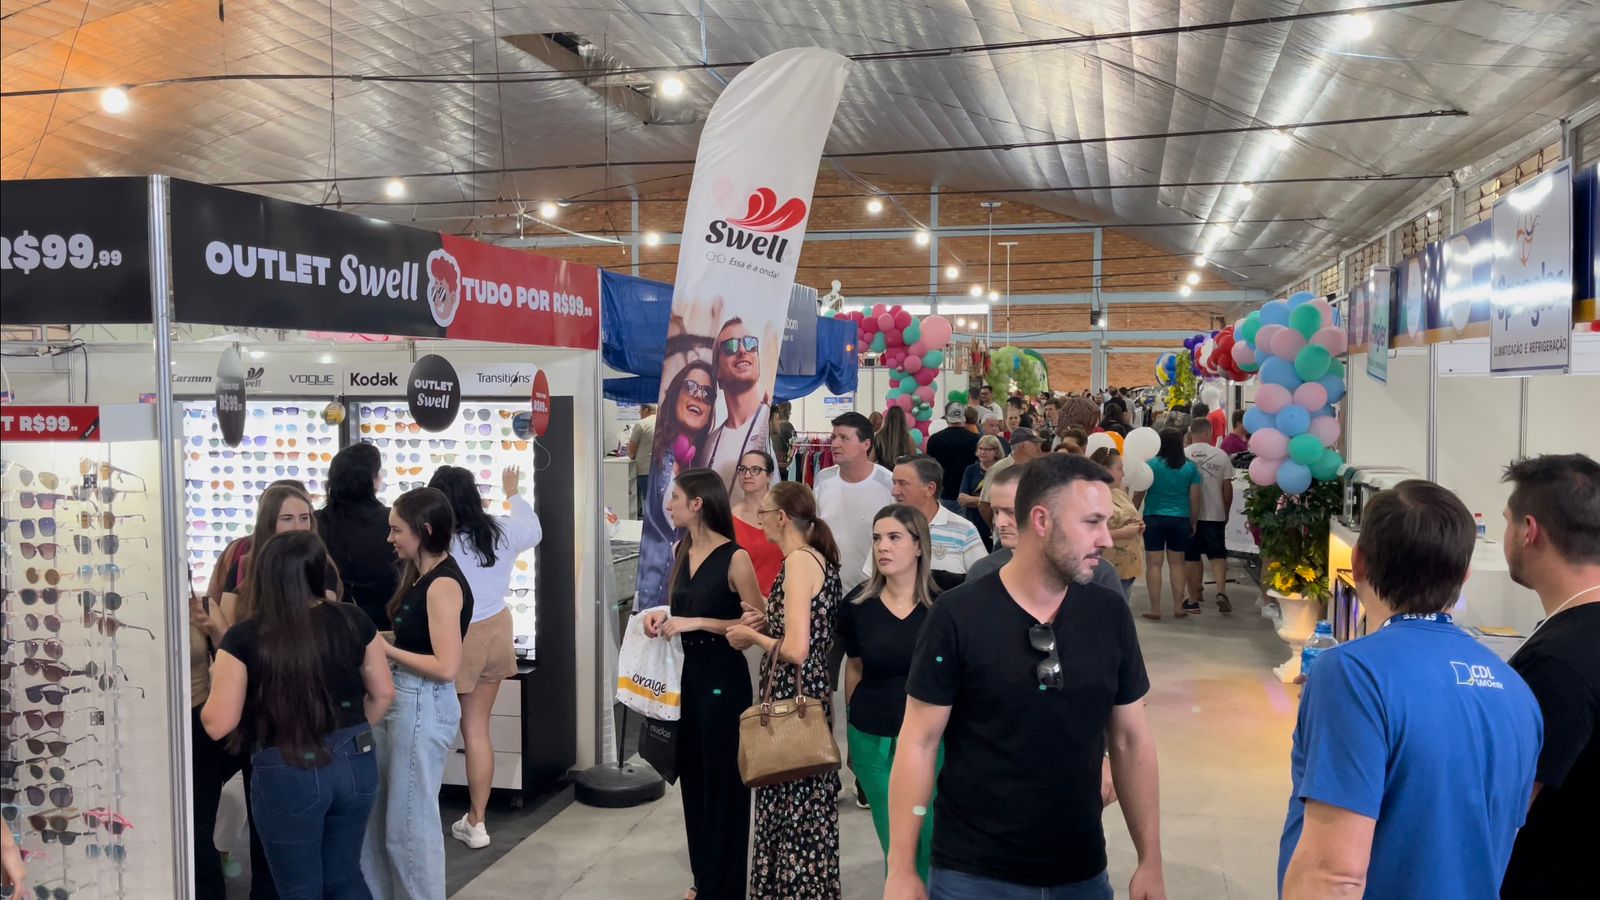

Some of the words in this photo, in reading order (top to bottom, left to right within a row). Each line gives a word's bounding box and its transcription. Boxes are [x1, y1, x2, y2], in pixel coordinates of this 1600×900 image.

[705, 219, 789, 263] Swell
[0, 230, 122, 275] R$99,99
[205, 240, 331, 286] OUTLET
[338, 253, 419, 301] Swell
[729, 257, 746, 268] Essa
[759, 268, 780, 278] onda!
[462, 276, 513, 307] TUDO
[516, 286, 550, 312] POR
[1524, 342, 1528, 354] E
[1529, 335, 1567, 354] REFRIGERAÇÃO
[350, 372, 398, 386] Kodak
[414, 379, 454, 392] OUTLET
[476, 371, 530, 387] Transitions
[417, 393, 450, 409] Swell
[1471, 665, 1495, 679] CDL
